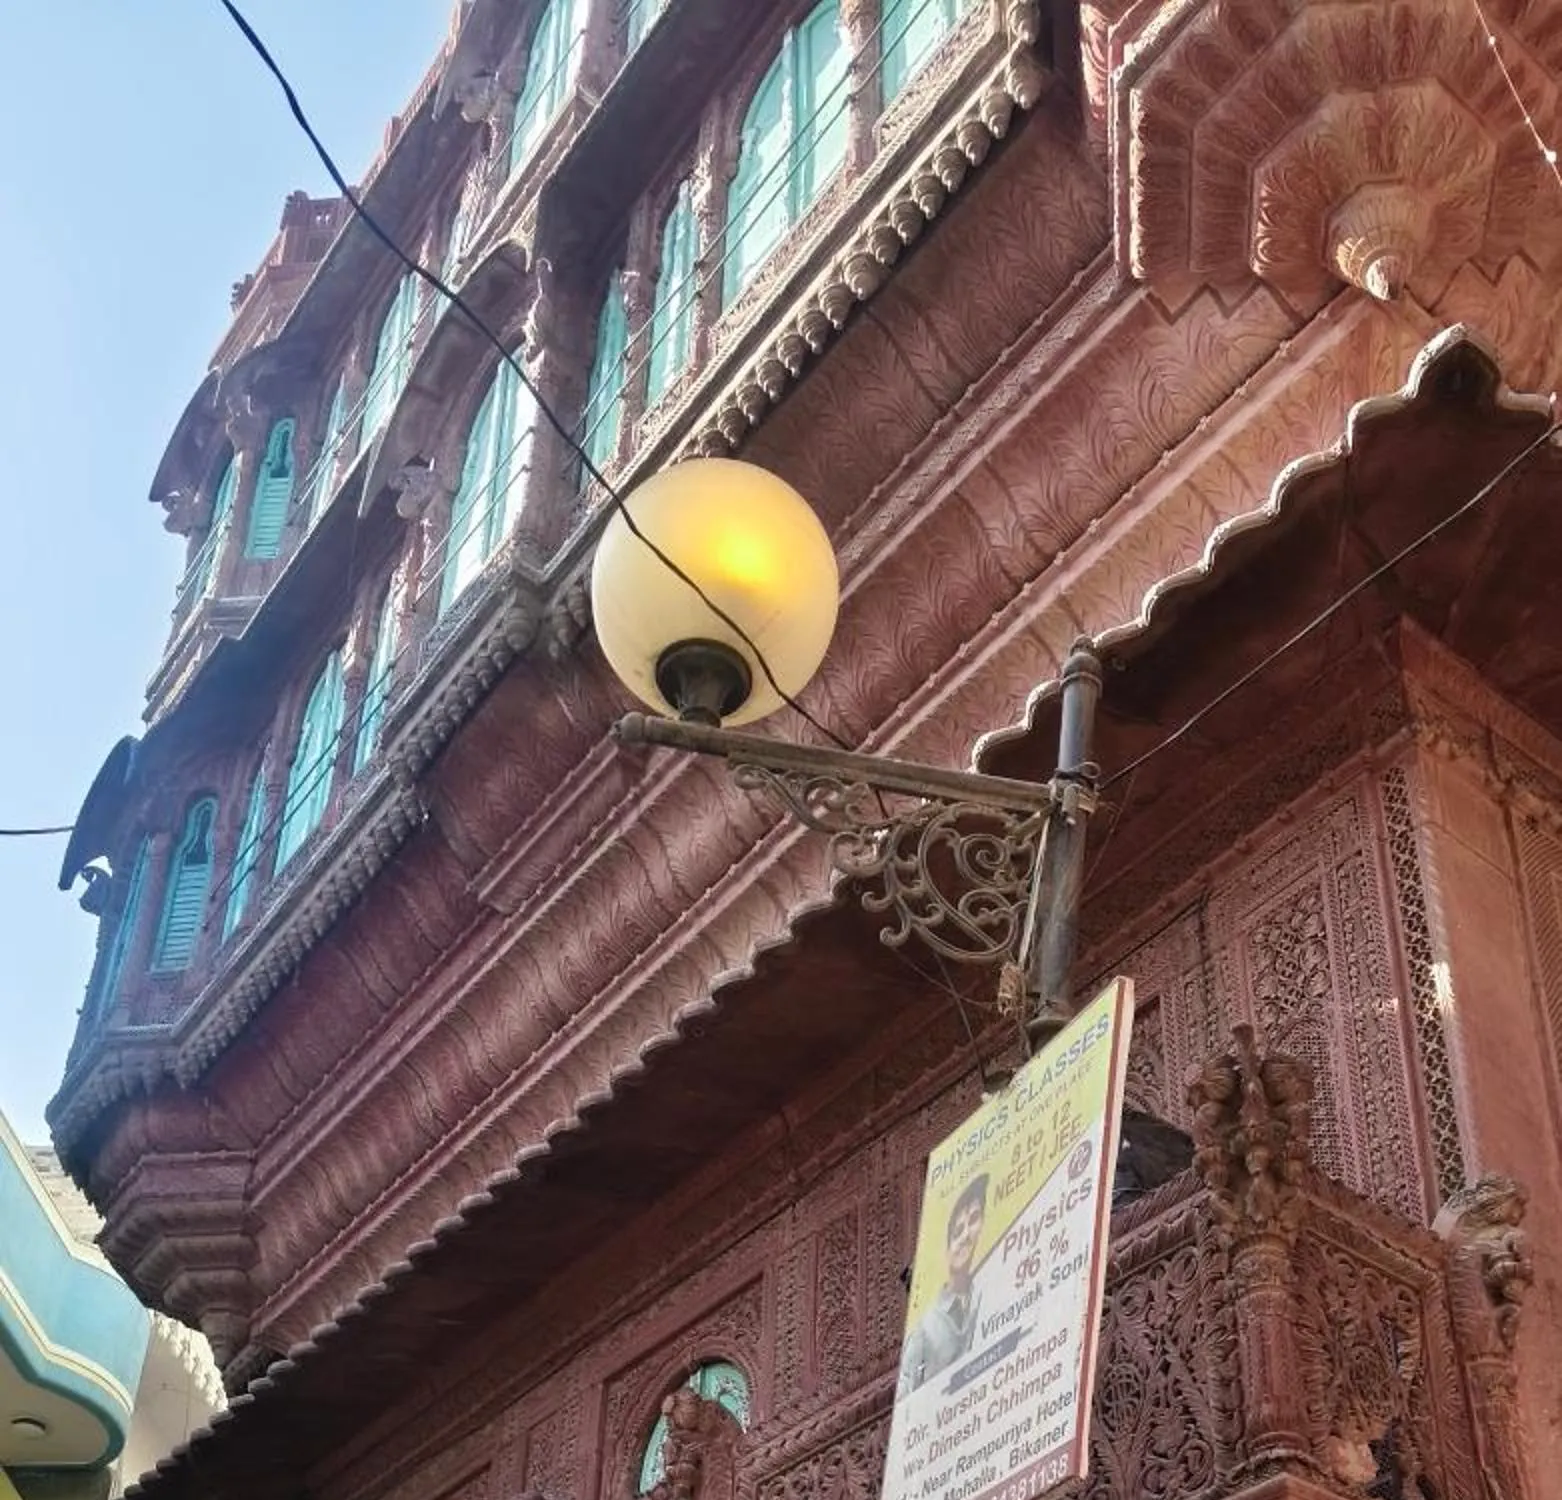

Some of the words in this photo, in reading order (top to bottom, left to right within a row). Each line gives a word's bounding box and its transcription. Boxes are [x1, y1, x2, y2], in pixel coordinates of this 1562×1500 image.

[931, 1105, 1009, 1188] PHYSICS
[1015, 1012, 1108, 1112] CLASSES
[1027, 1129, 1044, 1149] to
[1053, 1101, 1070, 1130] 12
[1003, 1178, 1092, 1263] Physics
[1015, 1248, 1041, 1290] 96
[1050, 1227, 1069, 1262] %
[981, 1282, 1043, 1339] Vinayak
[1049, 1242, 1088, 1290] Soni
[929, 1412, 981, 1464] Dinesh
[987, 1361, 1062, 1424] Chhimpa
[936, 1382, 987, 1429] Varsha
[992, 1326, 1068, 1391] Chhimpa
[921, 1466, 953, 1499] Near
[956, 1416, 1033, 1477] Rampuriya
[1008, 1419, 1070, 1470] Bikaner
